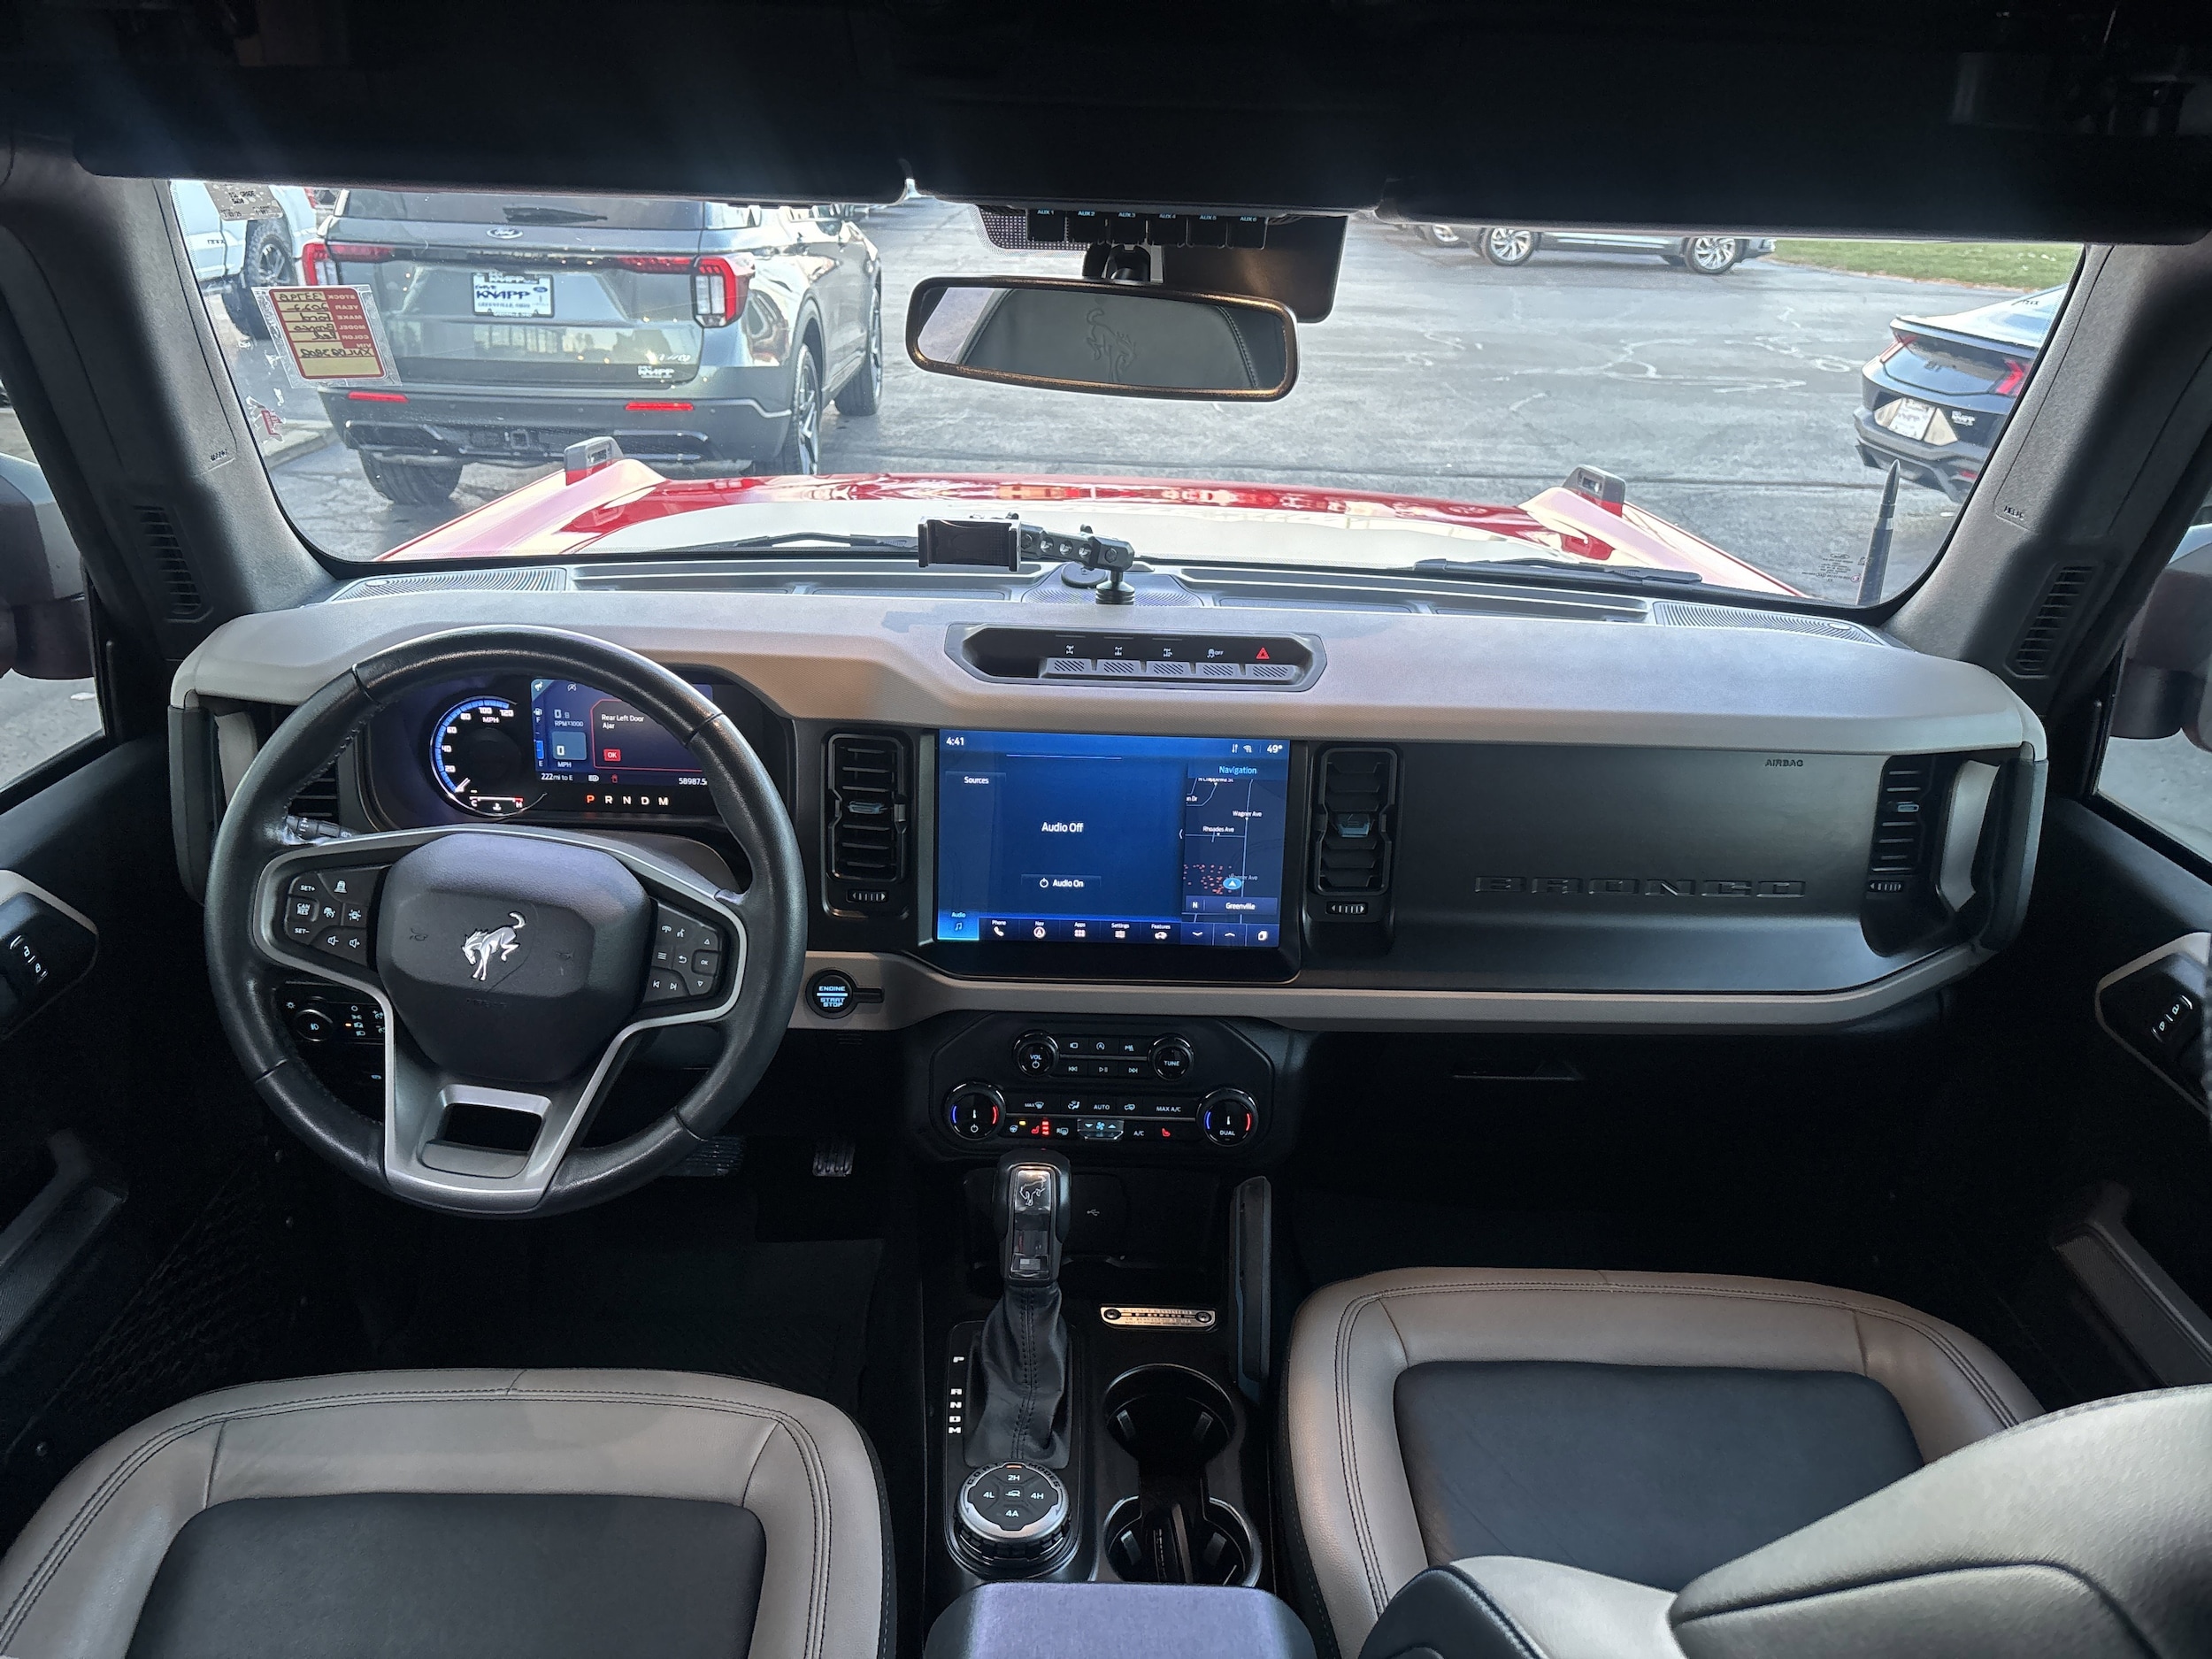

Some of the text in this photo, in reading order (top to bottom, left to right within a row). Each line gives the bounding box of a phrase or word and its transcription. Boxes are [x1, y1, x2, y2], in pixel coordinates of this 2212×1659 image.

[476, 290, 531, 300] KNAPP
[946, 736, 964, 746] 4:41
[557, 745, 565, 756] 0
[1218, 765, 1257, 775] Navigation
[587, 795, 595, 803] P
[604, 795, 613, 804] R
[623, 795, 632, 804] N
[641, 796, 649, 805] D
[1041, 822, 1084, 833] Audio Off
[1052, 879, 1072, 887] Audio
[1475, 877, 1806, 897] BRONCO
[1225, 902, 1256, 910] Greenville
